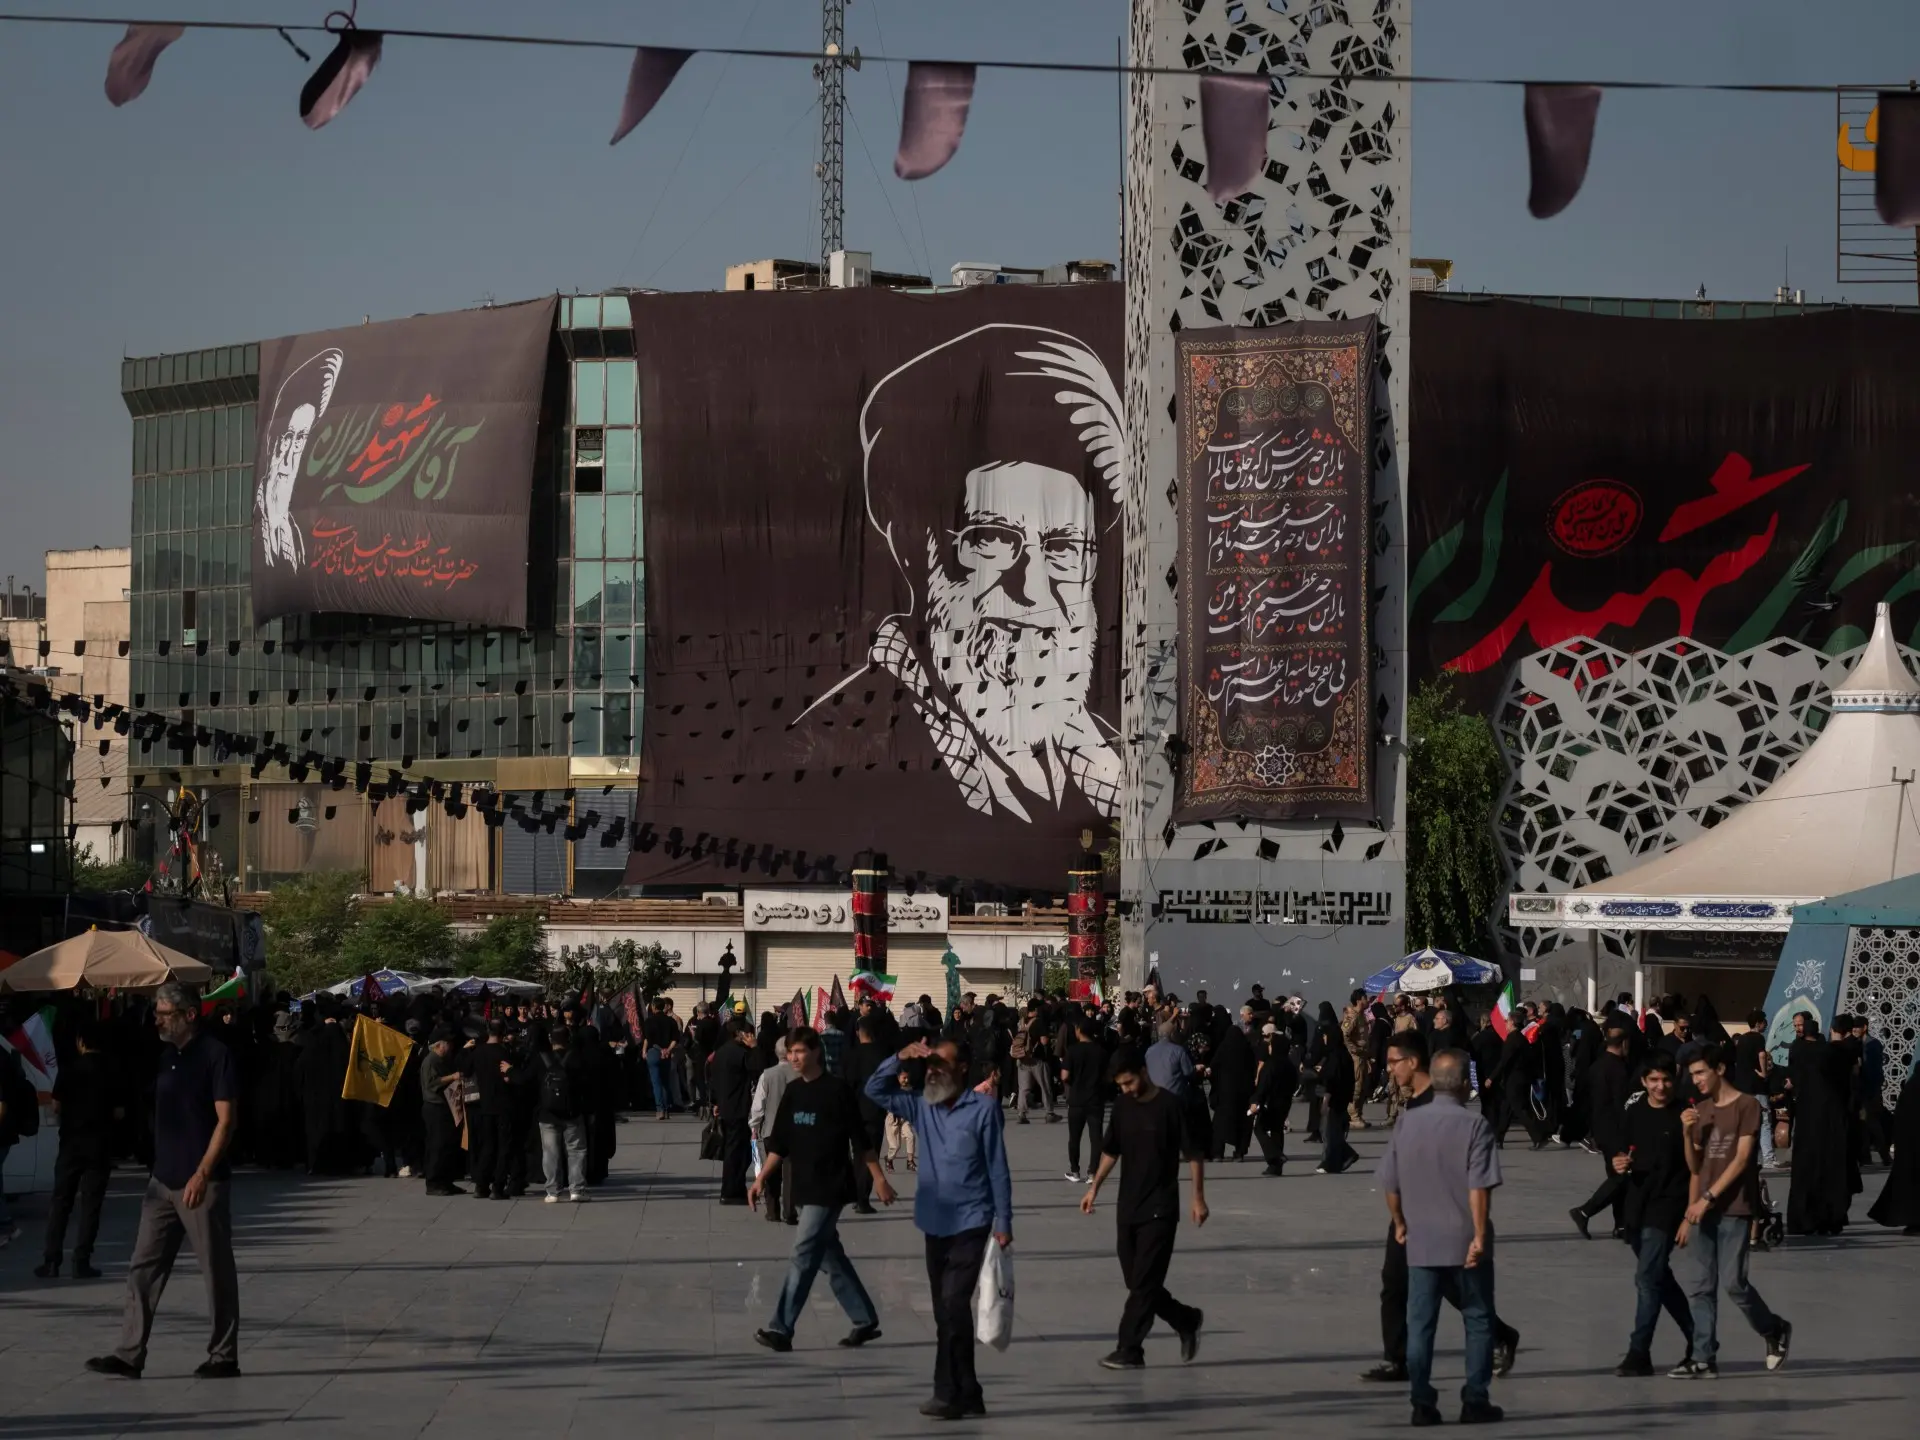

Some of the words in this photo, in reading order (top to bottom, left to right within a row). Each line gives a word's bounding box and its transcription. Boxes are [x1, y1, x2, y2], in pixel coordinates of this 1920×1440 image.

[306, 403, 381, 481] ایران
[347, 393, 442, 484] شهید
[1441, 451, 1812, 678] شهید
[752, 902, 810, 925] محسن
